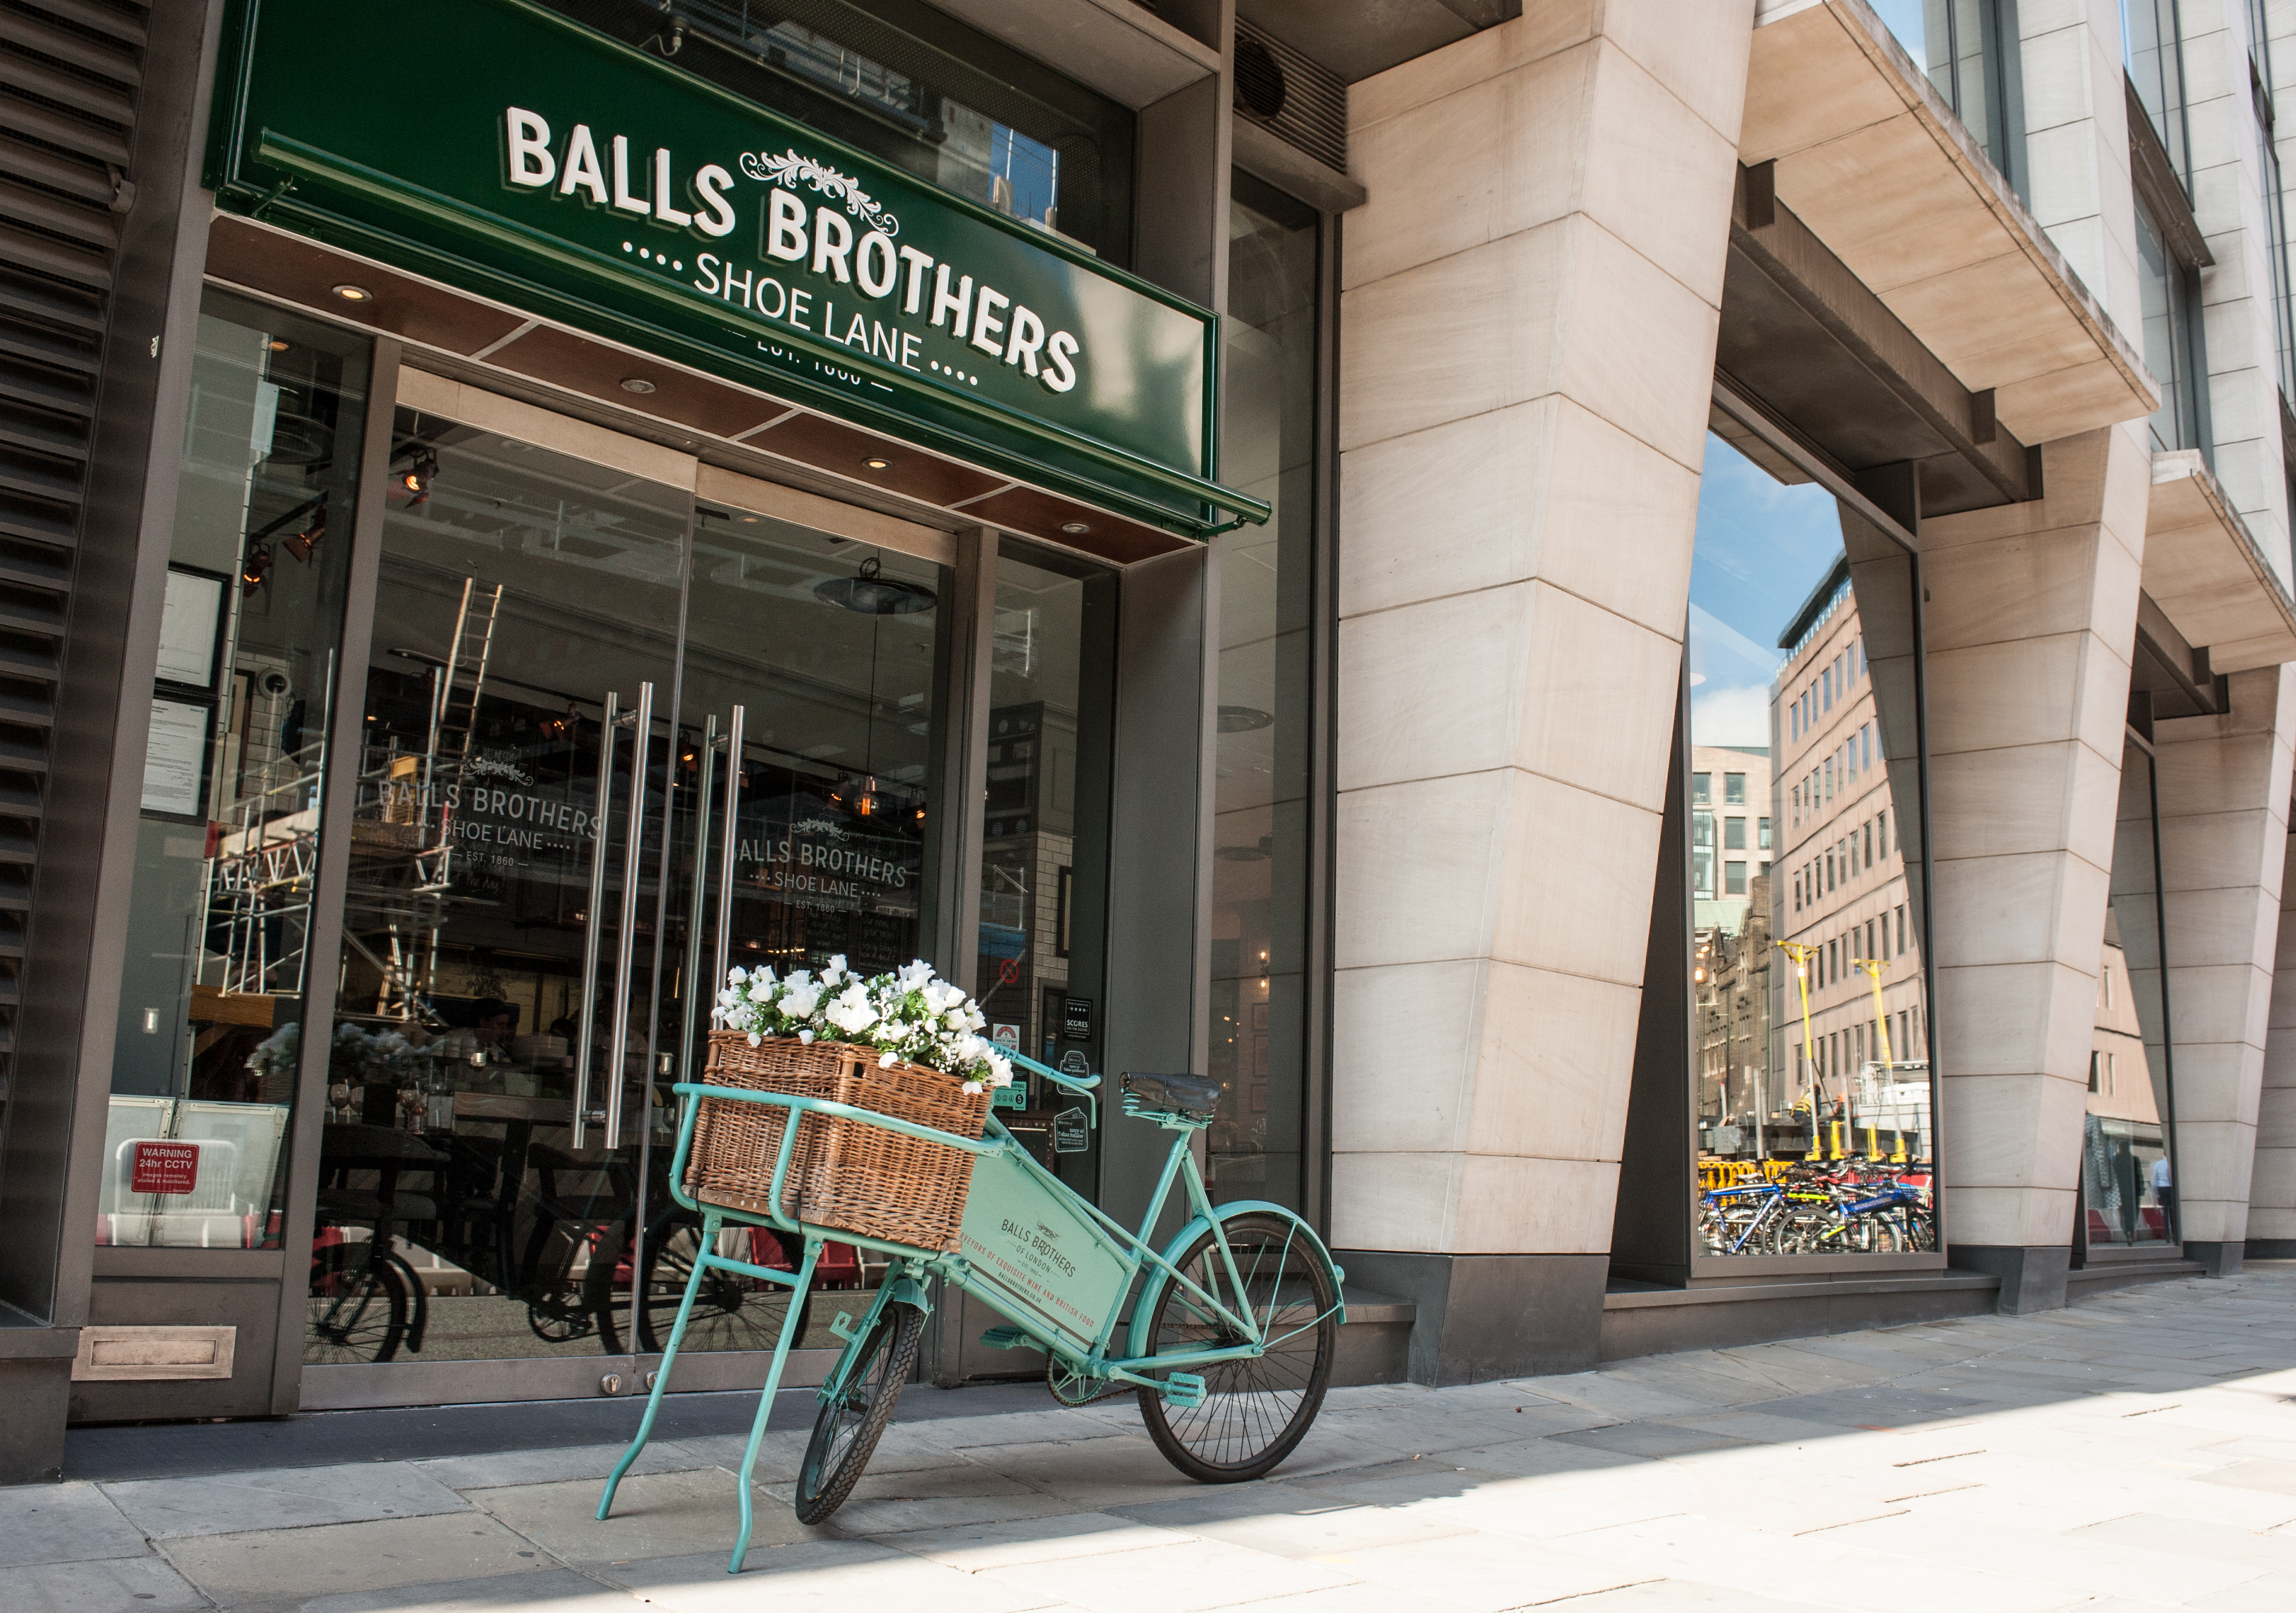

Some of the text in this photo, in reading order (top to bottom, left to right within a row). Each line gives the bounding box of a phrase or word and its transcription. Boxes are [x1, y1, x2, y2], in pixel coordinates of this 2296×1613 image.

[506, 106, 1080, 393] BALLS BROTHERS
[693, 252, 923, 372] SHOE LANE
[378, 780, 602, 840] BALLS BROTHERS
[441, 818, 492, 842] SHOE
[497, 826, 544, 850] LANE
[466, 851, 515, 866] EST. 1860
[734, 839, 791, 864] ALLS
[801, 843, 907, 888] BROTHERS
[774, 871, 859, 898] SHOE LANE
[796, 900, 835, 914] EST. 1860
[1067, 1019, 1088, 1028] SCORES
[139, 1159, 193, 1169] 24hr CCTV
[142, 1147, 192, 1158] WARNING
[1001, 1218, 1076, 1278] BALLS BROTHERS
[1016, 1245, 1051, 1273] OF LONDON
[959, 1232, 1094, 1328] RVEYORS OF EXQUISITE WINE AND BRITISH FOOD
